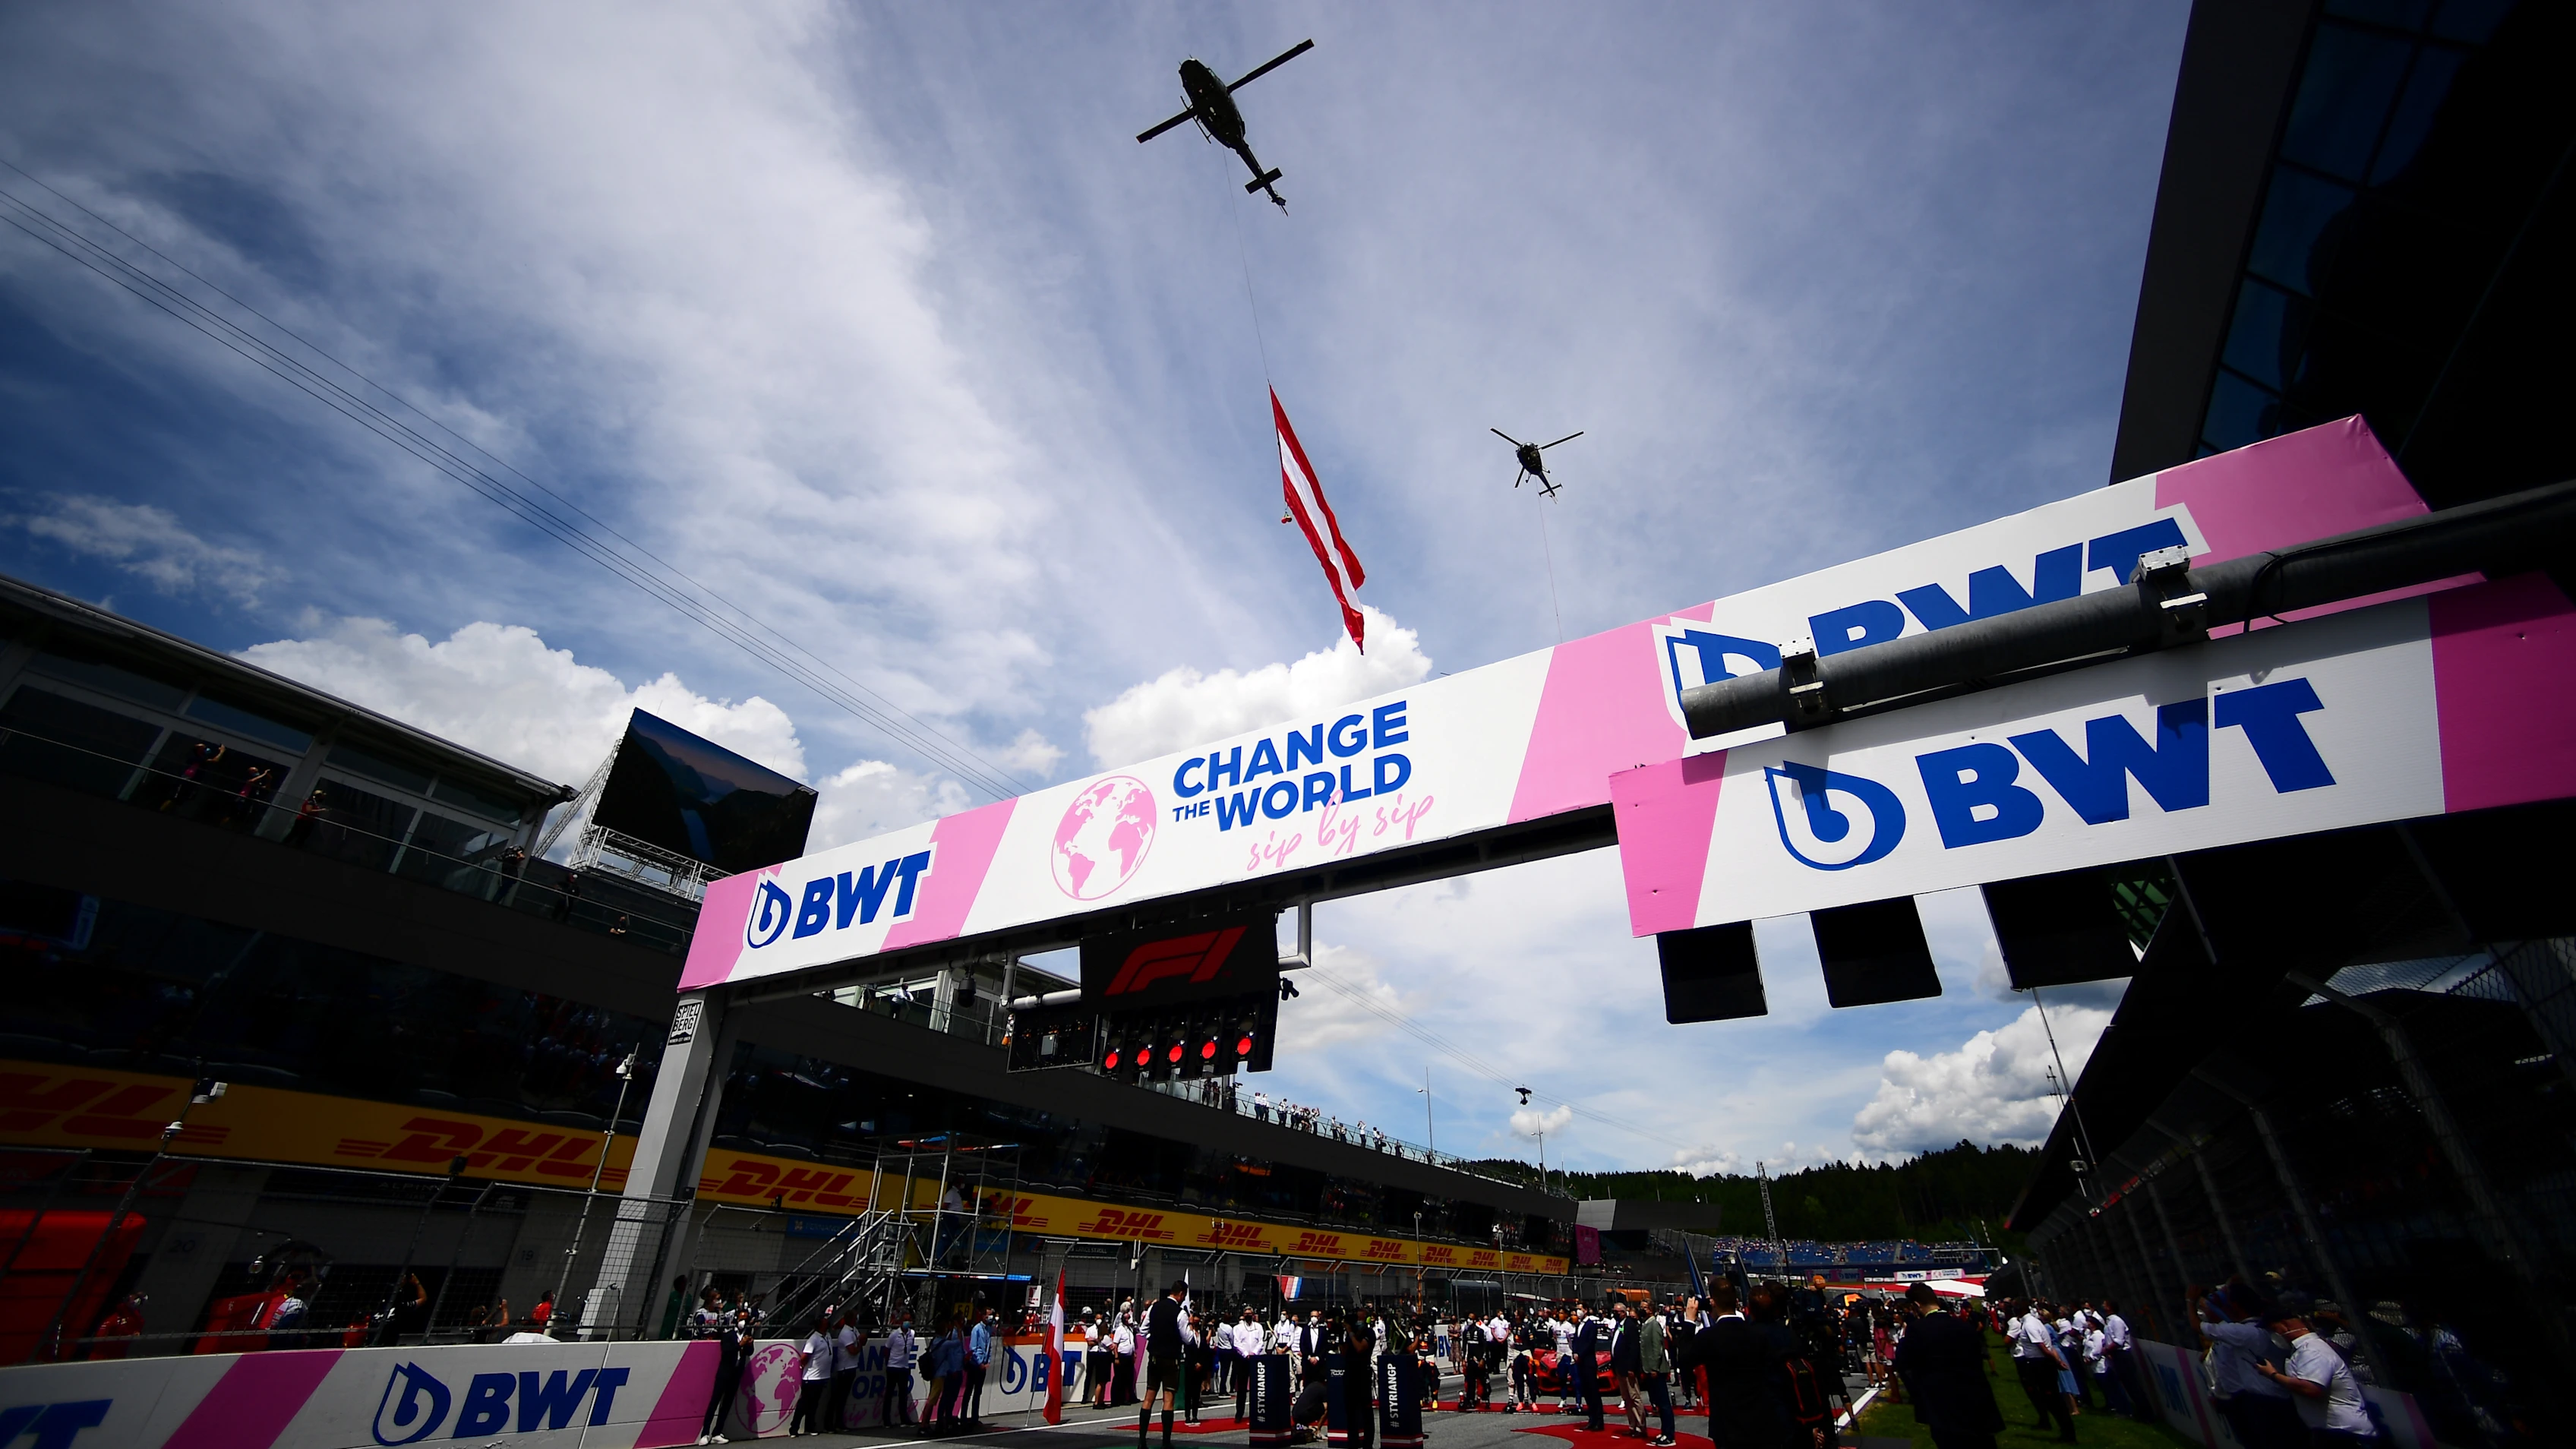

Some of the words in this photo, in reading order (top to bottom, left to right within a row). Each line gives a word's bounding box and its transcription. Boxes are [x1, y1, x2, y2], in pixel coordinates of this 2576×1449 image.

[1173, 699, 1410, 799] CHANGE
[1915, 678, 2336, 848] BWT
[1172, 797, 1211, 822] THE
[1215, 753, 1413, 832] WORLD
[1245, 829, 1304, 872] sip
[1318, 788, 1360, 856] by
[1373, 793, 1435, 841] sip
[791, 850, 931, 939] BWT
[1104, 925, 1249, 996] F1
[672, 1017, 695, 1032] BERG
[0, 1072, 167, 1139] HL
[380, 1116, 598, 1179] DHL
[716, 1159, 856, 1208] DHL
[1092, 1208, 1164, 1239] DHL
[1209, 1223, 1264, 1247] DHL
[1296, 1232, 1341, 1255] DHL
[1366, 1240, 1402, 1260] DHL
[1422, 1246, 1454, 1264] DHL
[1471, 1251, 1495, 1267] DHL
[1511, 1255, 1532, 1270] DHL
[1545, 1258, 1562, 1272] DHL
[1031, 1350, 1082, 1392] BT
[453, 1366, 630, 1438] BWT
